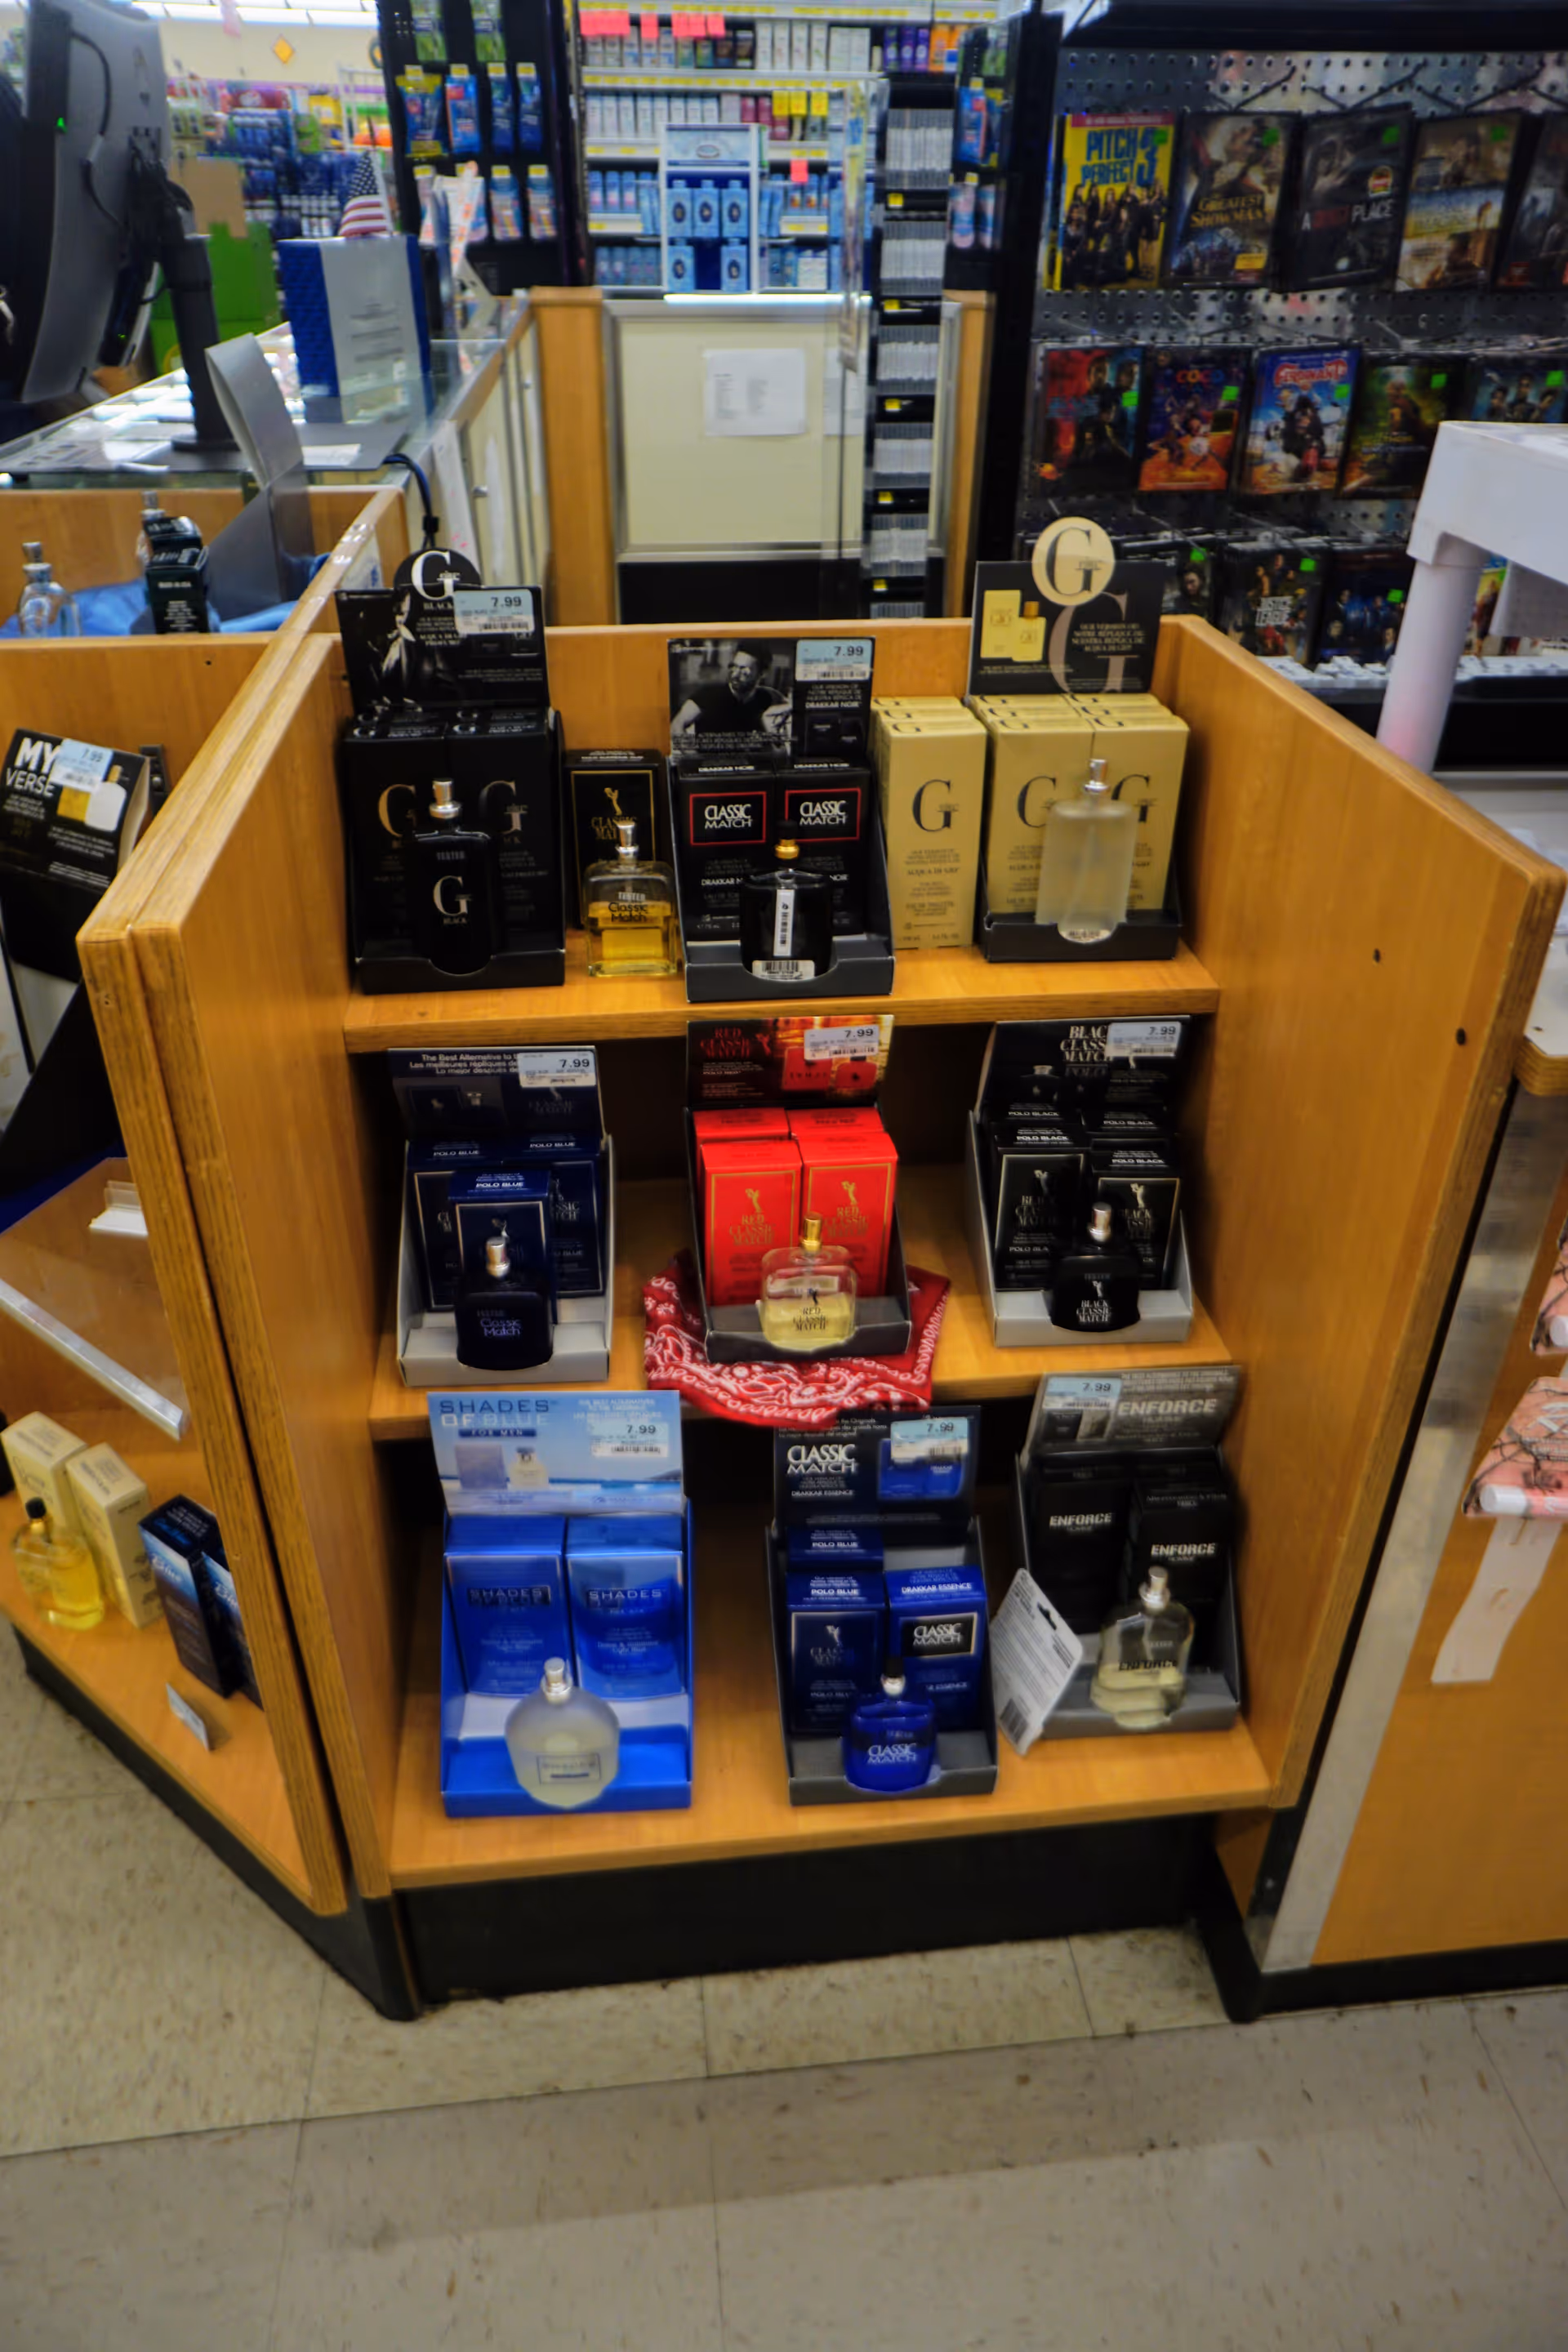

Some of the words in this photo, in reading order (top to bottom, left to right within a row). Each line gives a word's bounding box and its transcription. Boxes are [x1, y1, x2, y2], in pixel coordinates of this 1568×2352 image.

[1086, 128, 1138, 162] PITCH
[1081, 158, 1135, 187] PERFECT
[1352, 198, 1394, 223] PLACE
[1176, 368, 1225, 385] COCO
[491, 596, 523, 608] 7.99
[1258, 595, 1294, 611] JUSTICE
[1255, 609, 1292, 627] LEAGUE
[833, 645, 865, 657] 7.99
[805, 701, 840, 709] DRAKKAR
[14, 737, 61, 775] MY
[6, 768, 56, 798] VERSE
[704, 804, 751, 820] CLASSIC
[800, 800, 846, 817] CLASSIC
[704, 818, 752, 830] MATCH
[800, 815, 846, 826] MATCH
[701, 877, 735, 886] DRAKKAR
[608, 902, 648, 914] Classic
[611, 912, 647, 923] Match
[844, 1027, 875, 1039] 7.99
[1069, 1025, 1107, 1039] BLAC
[1148, 1026, 1177, 1036] 7.99
[1060, 1039, 1106, 1051] CLASS
[421, 1054, 438, 1062] The
[439, 1054, 457, 1062] Best
[459, 1053, 501, 1061] Alternative
[559, 1058, 590, 1068] 7.99
[1080, 1299, 1110, 1308] BLACK
[480, 1318, 522, 1330] Classic
[483, 1326, 521, 1337] Match
[1082, 1382, 1111, 1392] 7.99
[439, 1398, 550, 1414] SHADES
[1117, 1398, 1218, 1416] ENFORCE
[440, 1413, 475, 1428] OF
[483, 1413, 550, 1427] BLUE
[626, 1425, 657, 1434] 7.99
[926, 1422, 955, 1433] 7.99
[786, 1443, 856, 1464] CLASSIC
[786, 1462, 857, 1475] MATCH
[1049, 1512, 1112, 1527] ENFORCE
[1151, 1543, 1216, 1557] ENFORCE
[469, 1588, 543, 1599] SHADES
[836, 1588, 858, 1596] BLUE
[901, 1584, 938, 1593] DRAKKAR
[938, 1582, 972, 1591] ESSENCE
[214, 1582, 239, 1609] Blu
[588, 1588, 662, 1600] SHADES
[913, 1623, 961, 1638] CLASSIC
[913, 1635, 961, 1646] MATCH
[866, 1743, 916, 1757] CLASSIC
[866, 1754, 916, 1764] MATCH
